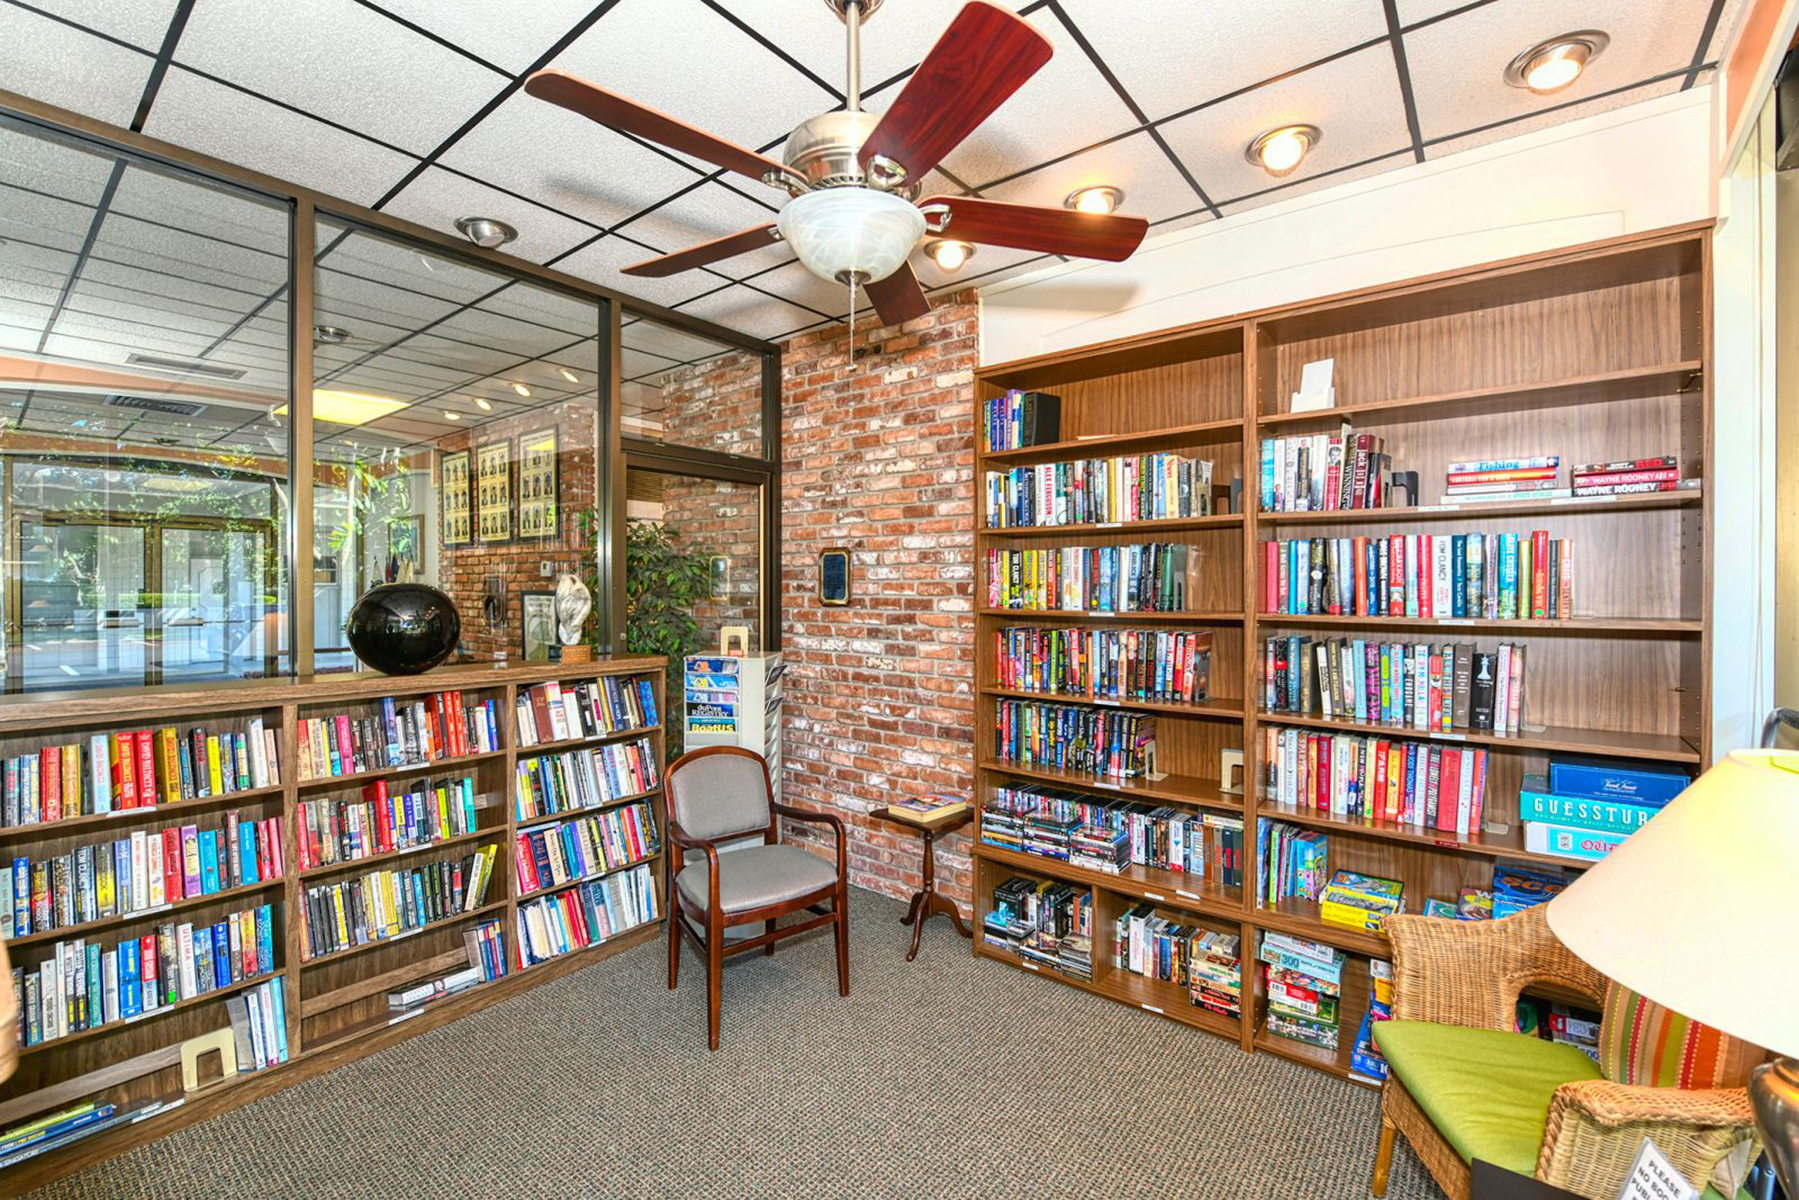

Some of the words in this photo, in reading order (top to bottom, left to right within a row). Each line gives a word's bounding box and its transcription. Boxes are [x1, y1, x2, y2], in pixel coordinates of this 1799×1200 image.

[1045, 466, 1053, 482] ALEX
[1479, 459, 1520, 470] Fishing
[1341, 466, 1352, 503] WINNING
[1578, 485, 1613, 496] WAYNE
[1614, 483, 1656, 494] ROONEY
[1592, 475, 1620, 484] WAYNE
[1621, 473, 1655, 482] ROONEY
[1045, 483, 1053, 516] FERGUSON
[1438, 541, 1447, 554] TOM
[1438, 555, 1447, 582] CLANCY
[1562, 588, 1570, 611] SENTRY
[1443, 652, 1452, 669] ALL
[1404, 678, 1413, 707] ENDGAME
[1443, 674, 1452, 695] THIS
[1443, 697, 1452, 717] LIFE
[692, 723, 734, 733] BoatUS
[121, 742, 130, 758] DAVID
[141, 741, 151, 759] DAVID
[1298, 738, 1306, 771] SPARTA
[1430, 753, 1439, 763] THE
[96, 760, 105, 784] BALDACCI
[122, 758, 132, 782] BALDACCI
[142, 759, 153, 788] BALDACCI
[168, 754, 178, 781] BALDACCI
[1378, 754, 1387, 783] FARM
[1429, 766, 1438, 784] LONELY
[1427, 786, 1437, 817] POLYGAMIST
[78, 849, 87, 863] TOM
[78, 863, 88, 889] CLANCY
[100, 872, 108, 891] COOK
[182, 928, 192, 961] ULTIMA
[1281, 954, 1300, 969] 300
[199, 966, 207, 990] JACKSON
[28, 1004, 37, 1023] GRAHAM
[1638, 1167, 1650, 1183] NO
[1651, 1181, 1670, 1200] BOO
[1648, 1160, 1681, 1198] PLEASE
